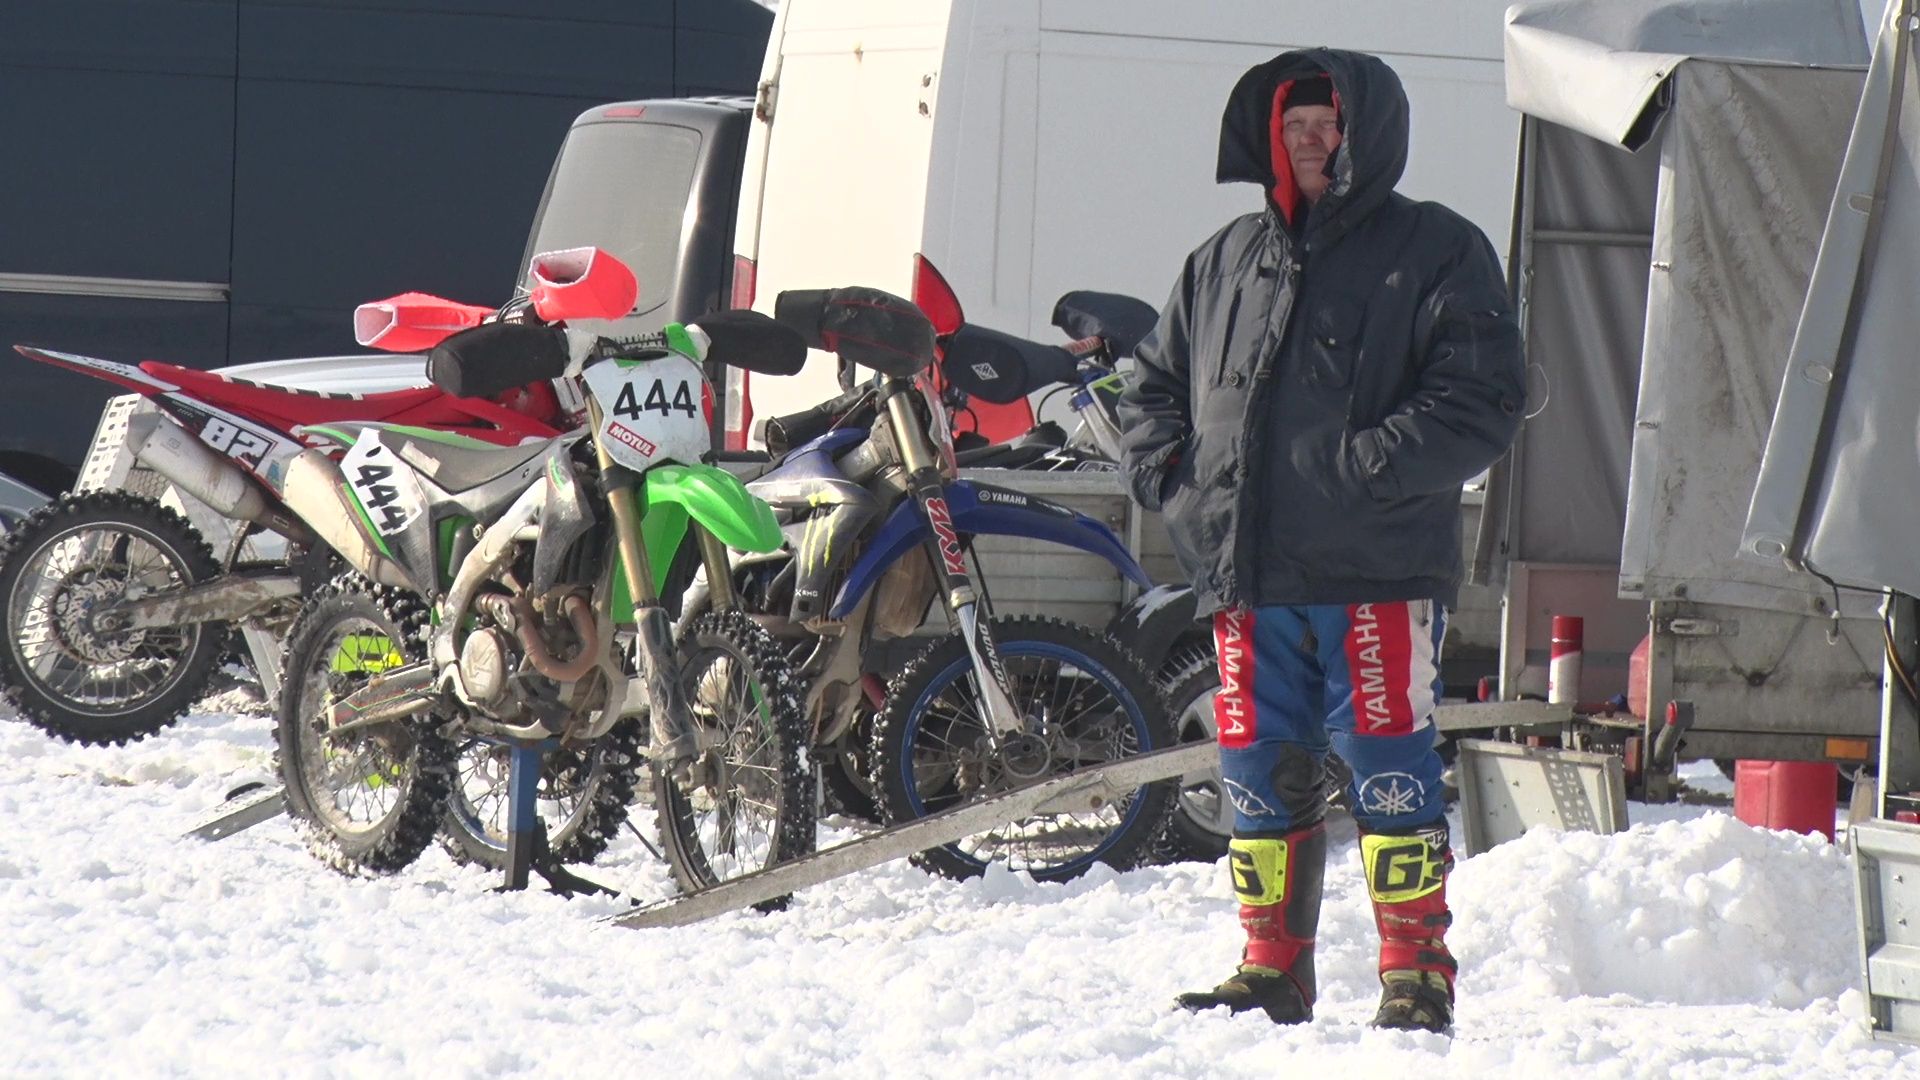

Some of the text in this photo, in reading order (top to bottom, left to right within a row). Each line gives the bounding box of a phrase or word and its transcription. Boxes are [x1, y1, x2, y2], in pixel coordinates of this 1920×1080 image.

[612, 378, 697, 421] 444
[200, 417, 270, 469] 82
[609, 424, 653, 456] MOTUL
[354, 465, 408, 532] 444
[991, 492, 1027, 505] YAMAHA
[925, 497, 968, 576] KYB
[978, 622, 1010, 695] DUNLOP
[1221, 608, 1245, 735] YAMAHA
[1353, 602, 1392, 732] YAMAHA
